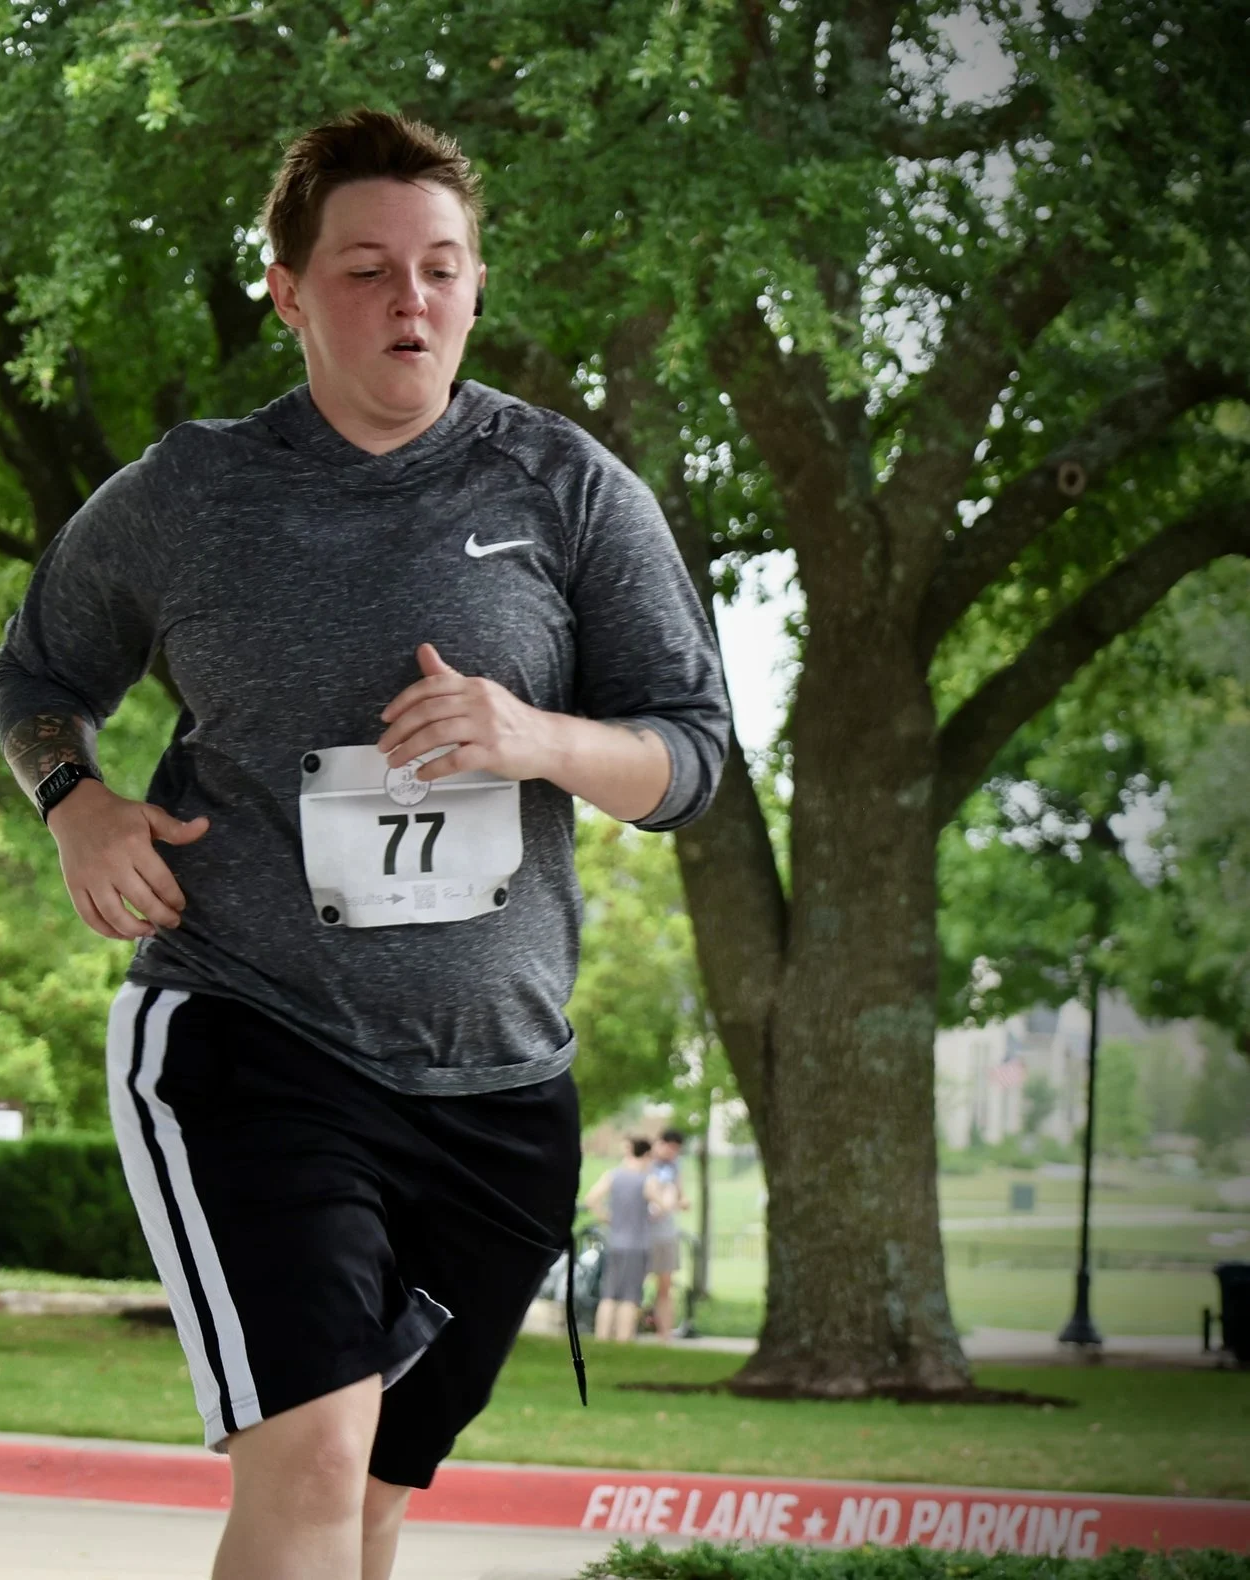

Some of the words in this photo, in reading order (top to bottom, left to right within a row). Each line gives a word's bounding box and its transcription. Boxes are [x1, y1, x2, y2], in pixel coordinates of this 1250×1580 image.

[378, 811, 446, 876] 77
[581, 1484, 680, 1532] FIRE
[678, 1488, 799, 1541] LANE
[834, 1497, 902, 1546] NO
[908, 1499, 1101, 1559] PARKING
